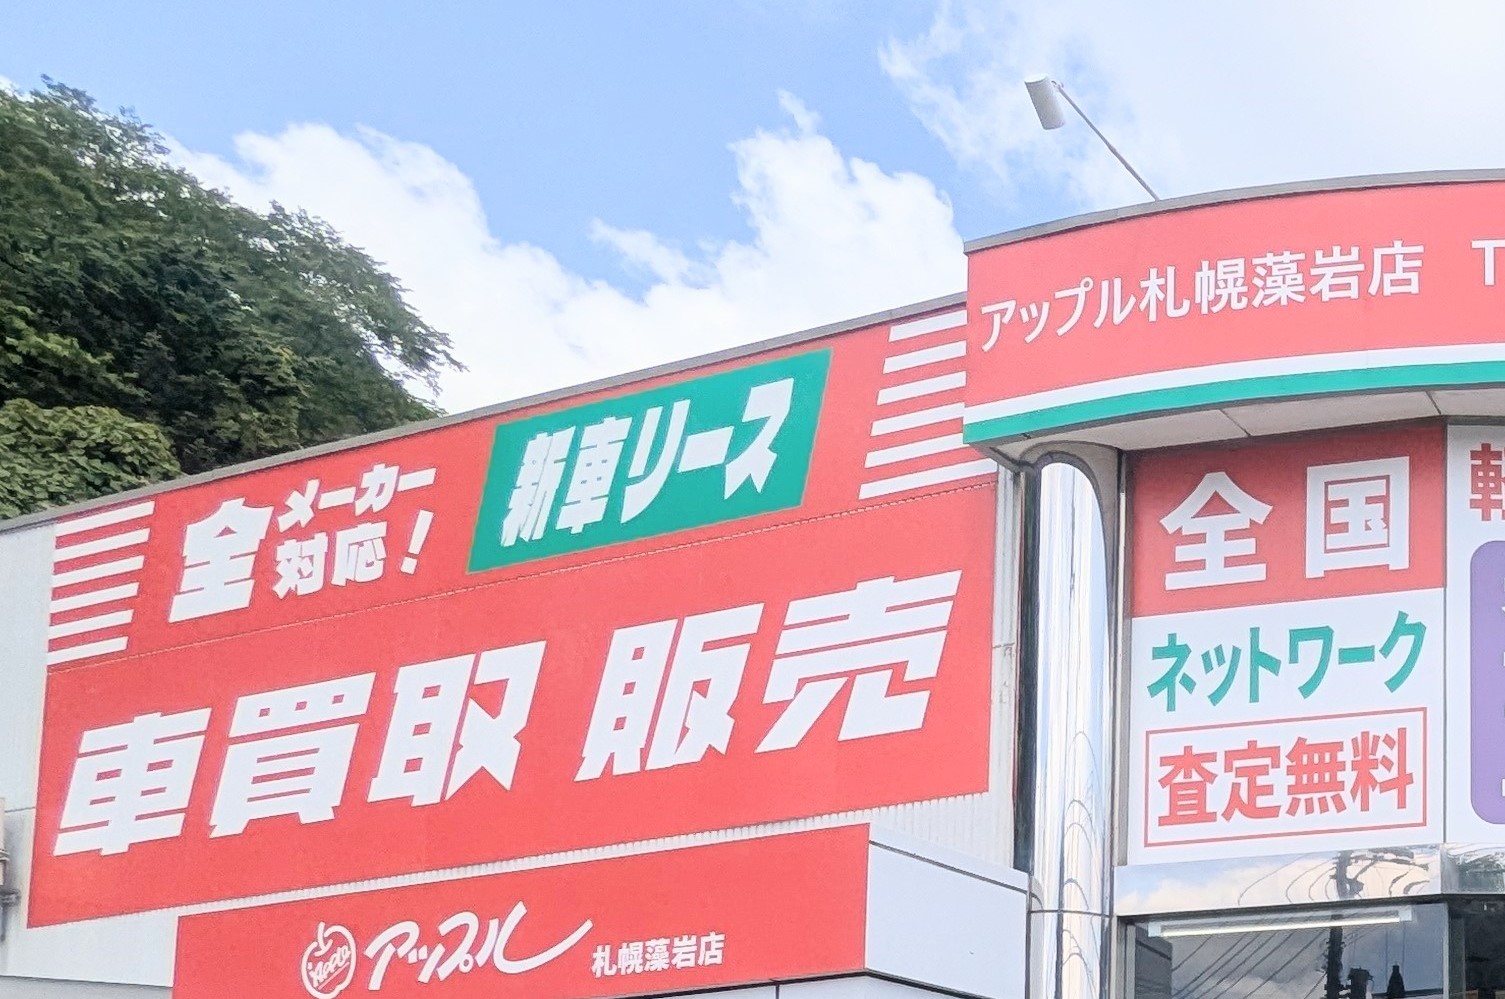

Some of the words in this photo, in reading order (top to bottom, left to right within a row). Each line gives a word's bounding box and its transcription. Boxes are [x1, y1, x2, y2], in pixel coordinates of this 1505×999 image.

[979, 239, 1425, 352] アップル札幌藻岩店
[277, 463, 438, 533] メーカー
[498, 376, 797, 548] 新車リース
[1147, 611, 1427, 712] ネットワーク
[52, 640, 547, 858] 車買取
[574, 569, 964, 782] 販売
[1157, 728, 1413, 827] 査定無料
[364, 900, 594, 992] アップル
[591, 931, 726, 979] 札幌藻岩店
